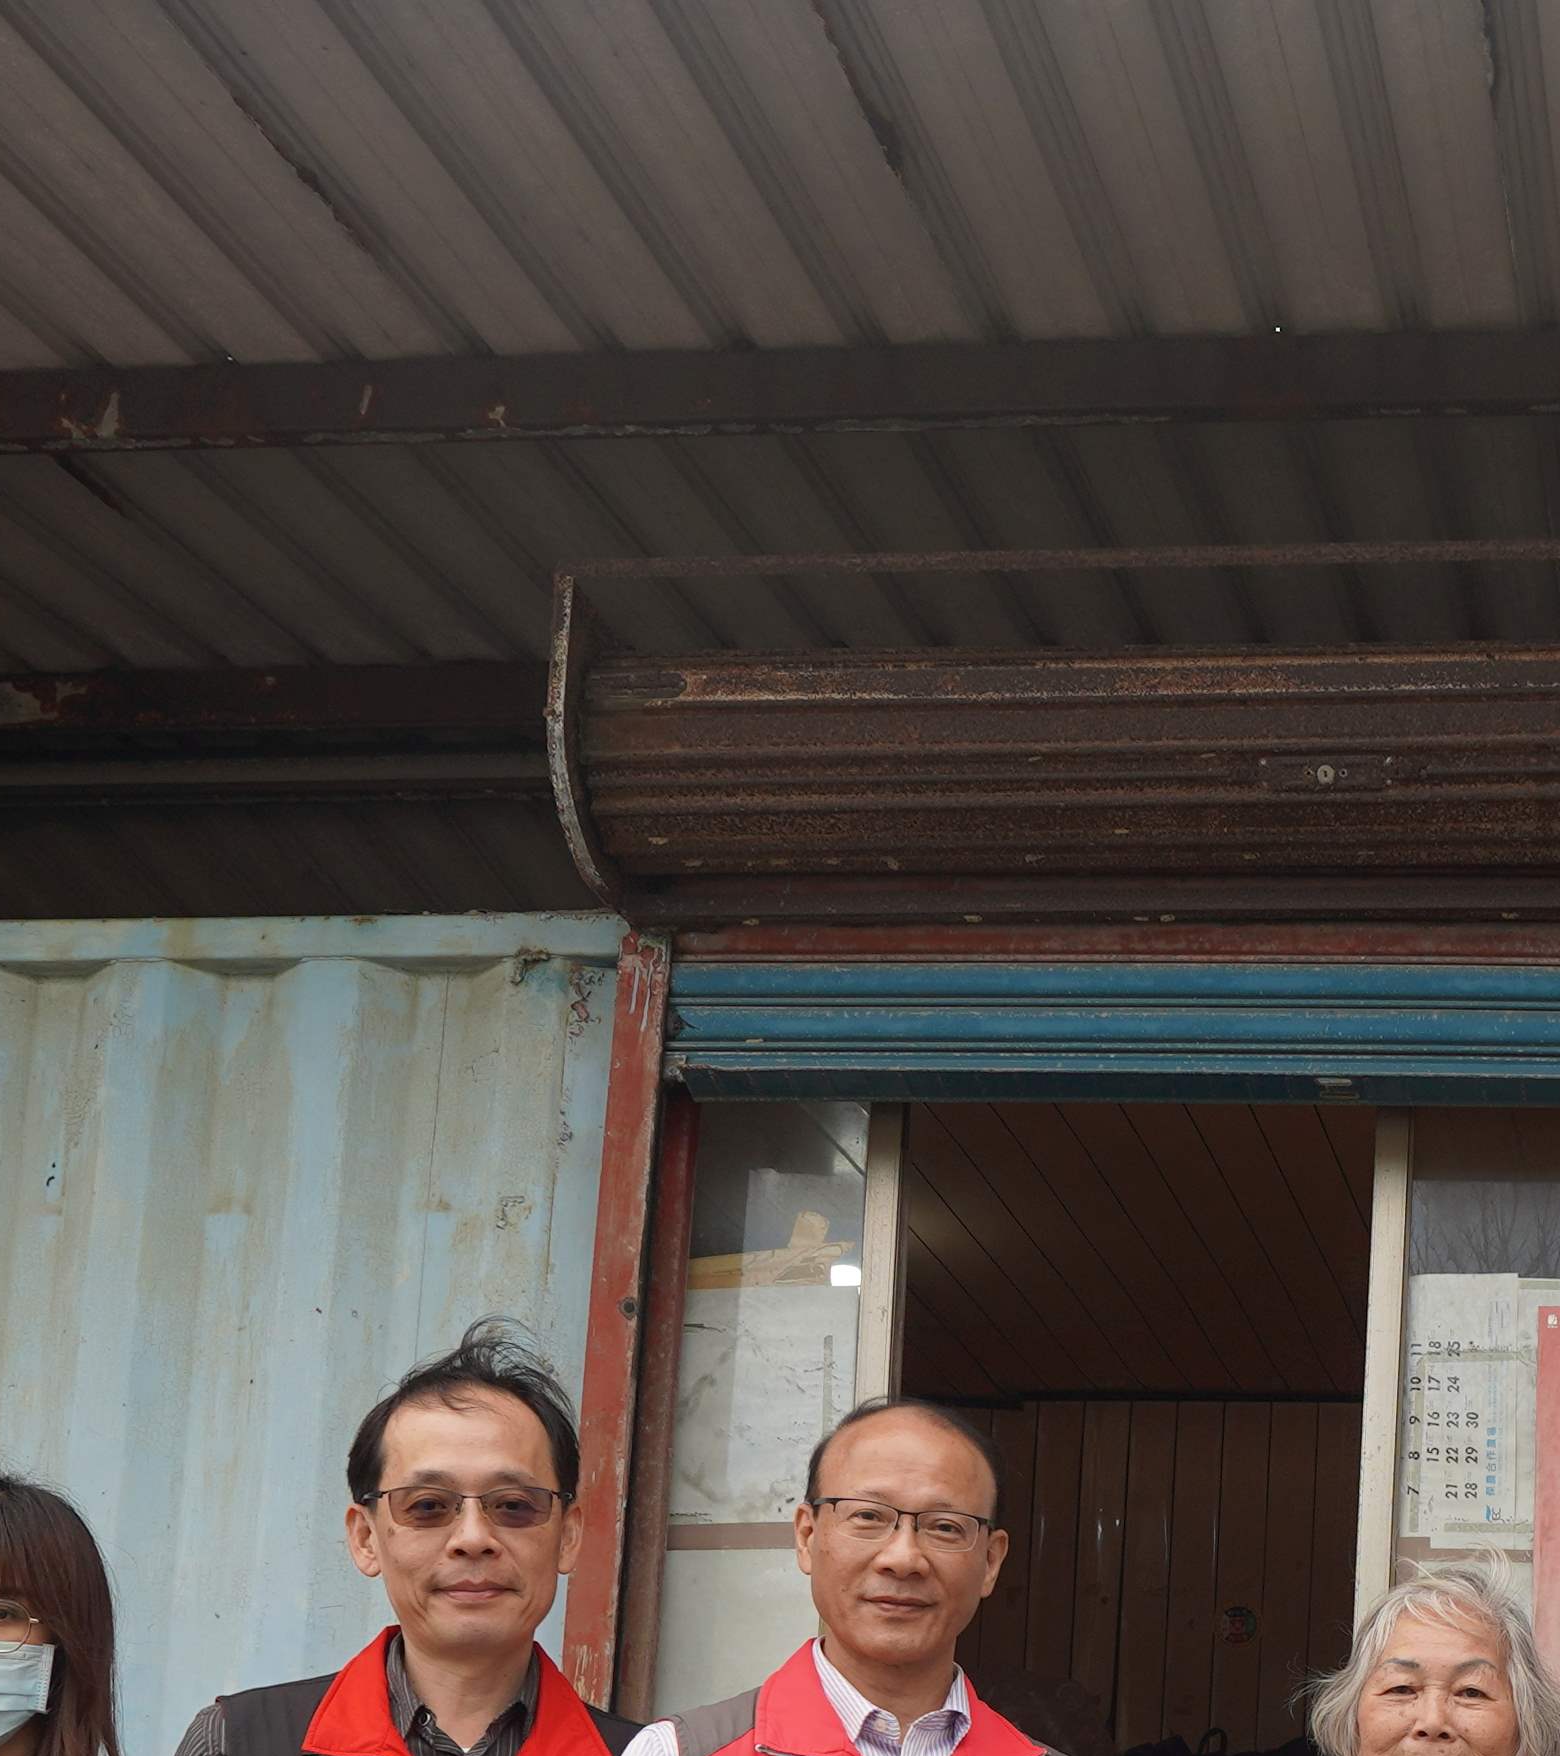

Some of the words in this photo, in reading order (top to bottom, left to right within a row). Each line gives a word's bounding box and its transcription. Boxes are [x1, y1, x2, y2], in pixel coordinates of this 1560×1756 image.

[1411, 1343, 1422, 1357] 11
[1429, 1341, 1442, 1356] 18
[1448, 1341, 1461, 1357] 25
[1410, 1376, 1422, 1392] 10
[1428, 1376, 1441, 1391] 17
[1447, 1376, 1460, 1393] 24
[1409, 1415, 1421, 1425] 9
[1427, 1411, 1440, 1427] 16
[1446, 1412, 1460, 1428] 23
[1466, 1412, 1479, 1429] 30
[1408, 1451, 1421, 1460] 8
[1427, 1447, 1440, 1462] 15
[1446, 1447, 1459, 1464] 22
[1465, 1446, 1478, 1464] 29
[1445, 1484, 1458, 1499] 21
[1465, 1482, 1478, 1499] 28
